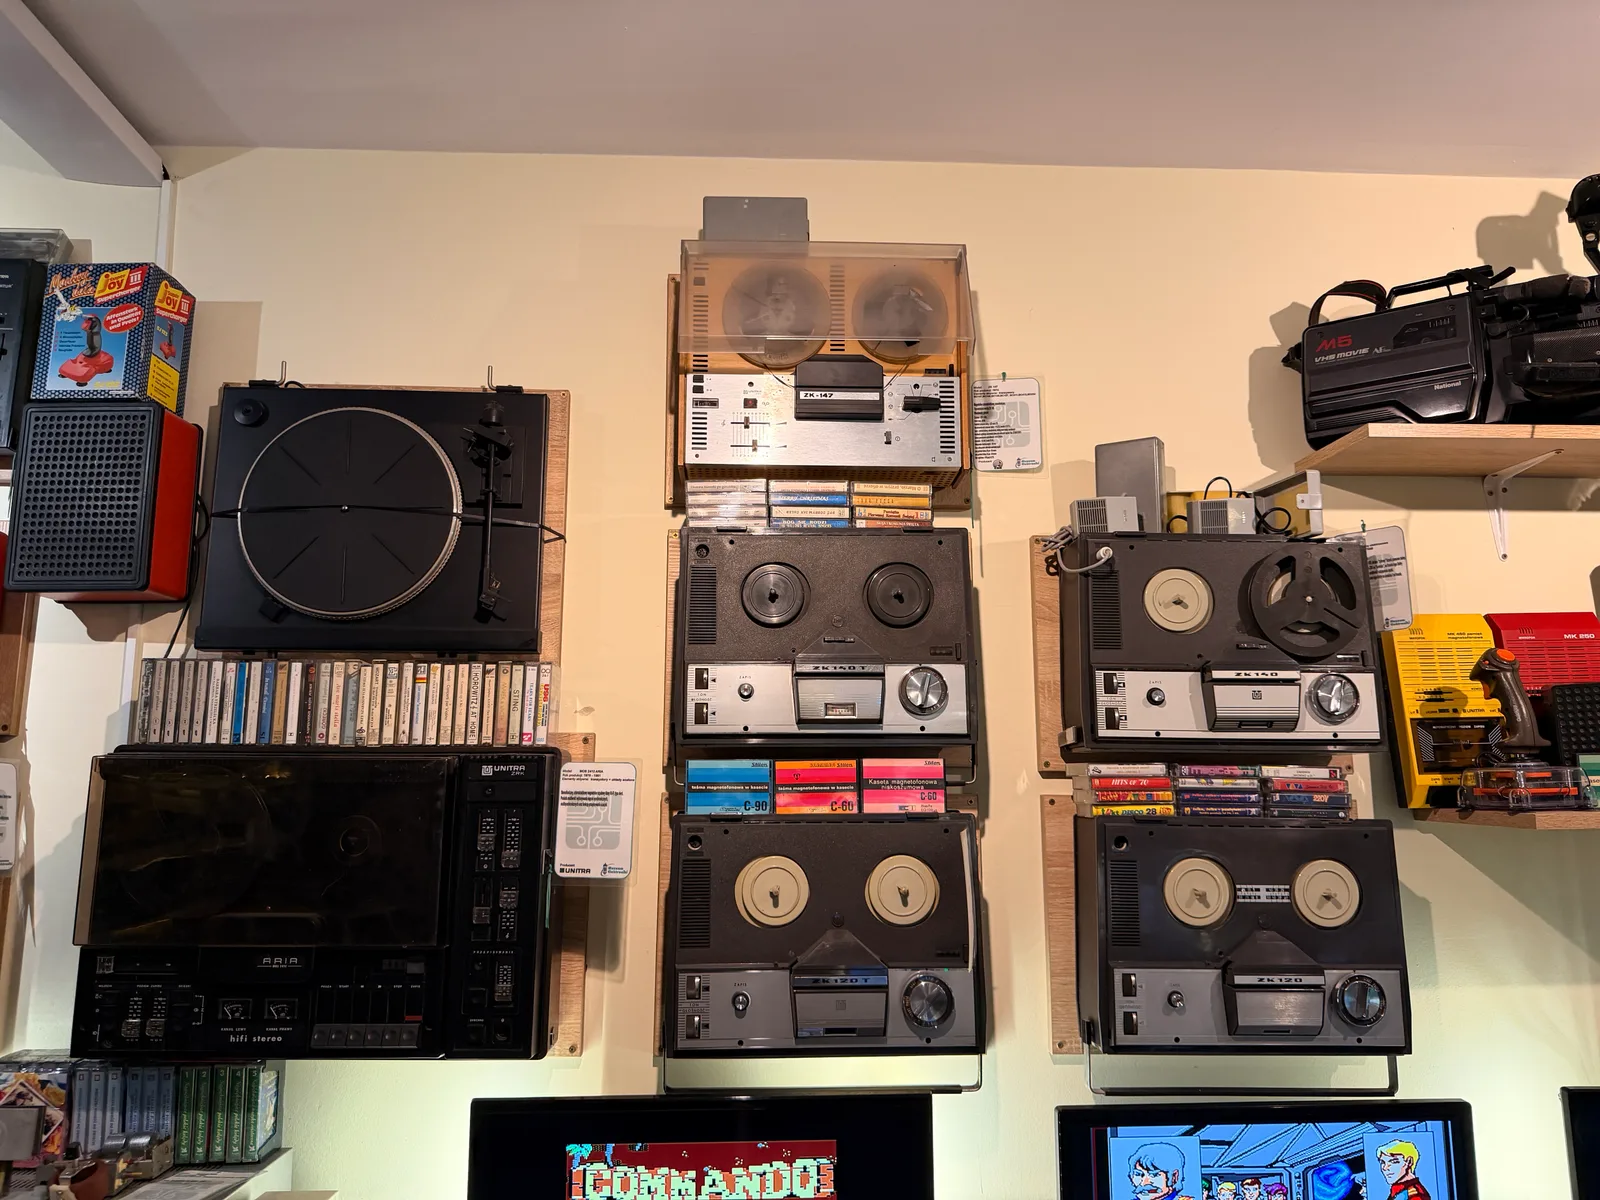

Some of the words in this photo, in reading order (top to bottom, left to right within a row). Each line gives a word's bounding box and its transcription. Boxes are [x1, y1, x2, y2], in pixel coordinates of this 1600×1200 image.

[97, 286, 141, 303] Supercharger
[1315, 334, 1353, 353] M5
[1314, 353, 1336, 363] VHS
[1434, 380, 1462, 391] National
[471, 672, 480, 705] HOROWITZ
[511, 689, 520, 712] STING
[470, 711, 477, 719] AT
[493, 765, 526, 773] UNITRA
[920, 791, 937, 801] C-60
[744, 800, 768, 811] C-90
[831, 800, 854, 811] C-60
[262, 957, 298, 965] ARIA
[229, 1034, 248, 1042] hifi
[584, 1159, 818, 1200] COMMANDO
